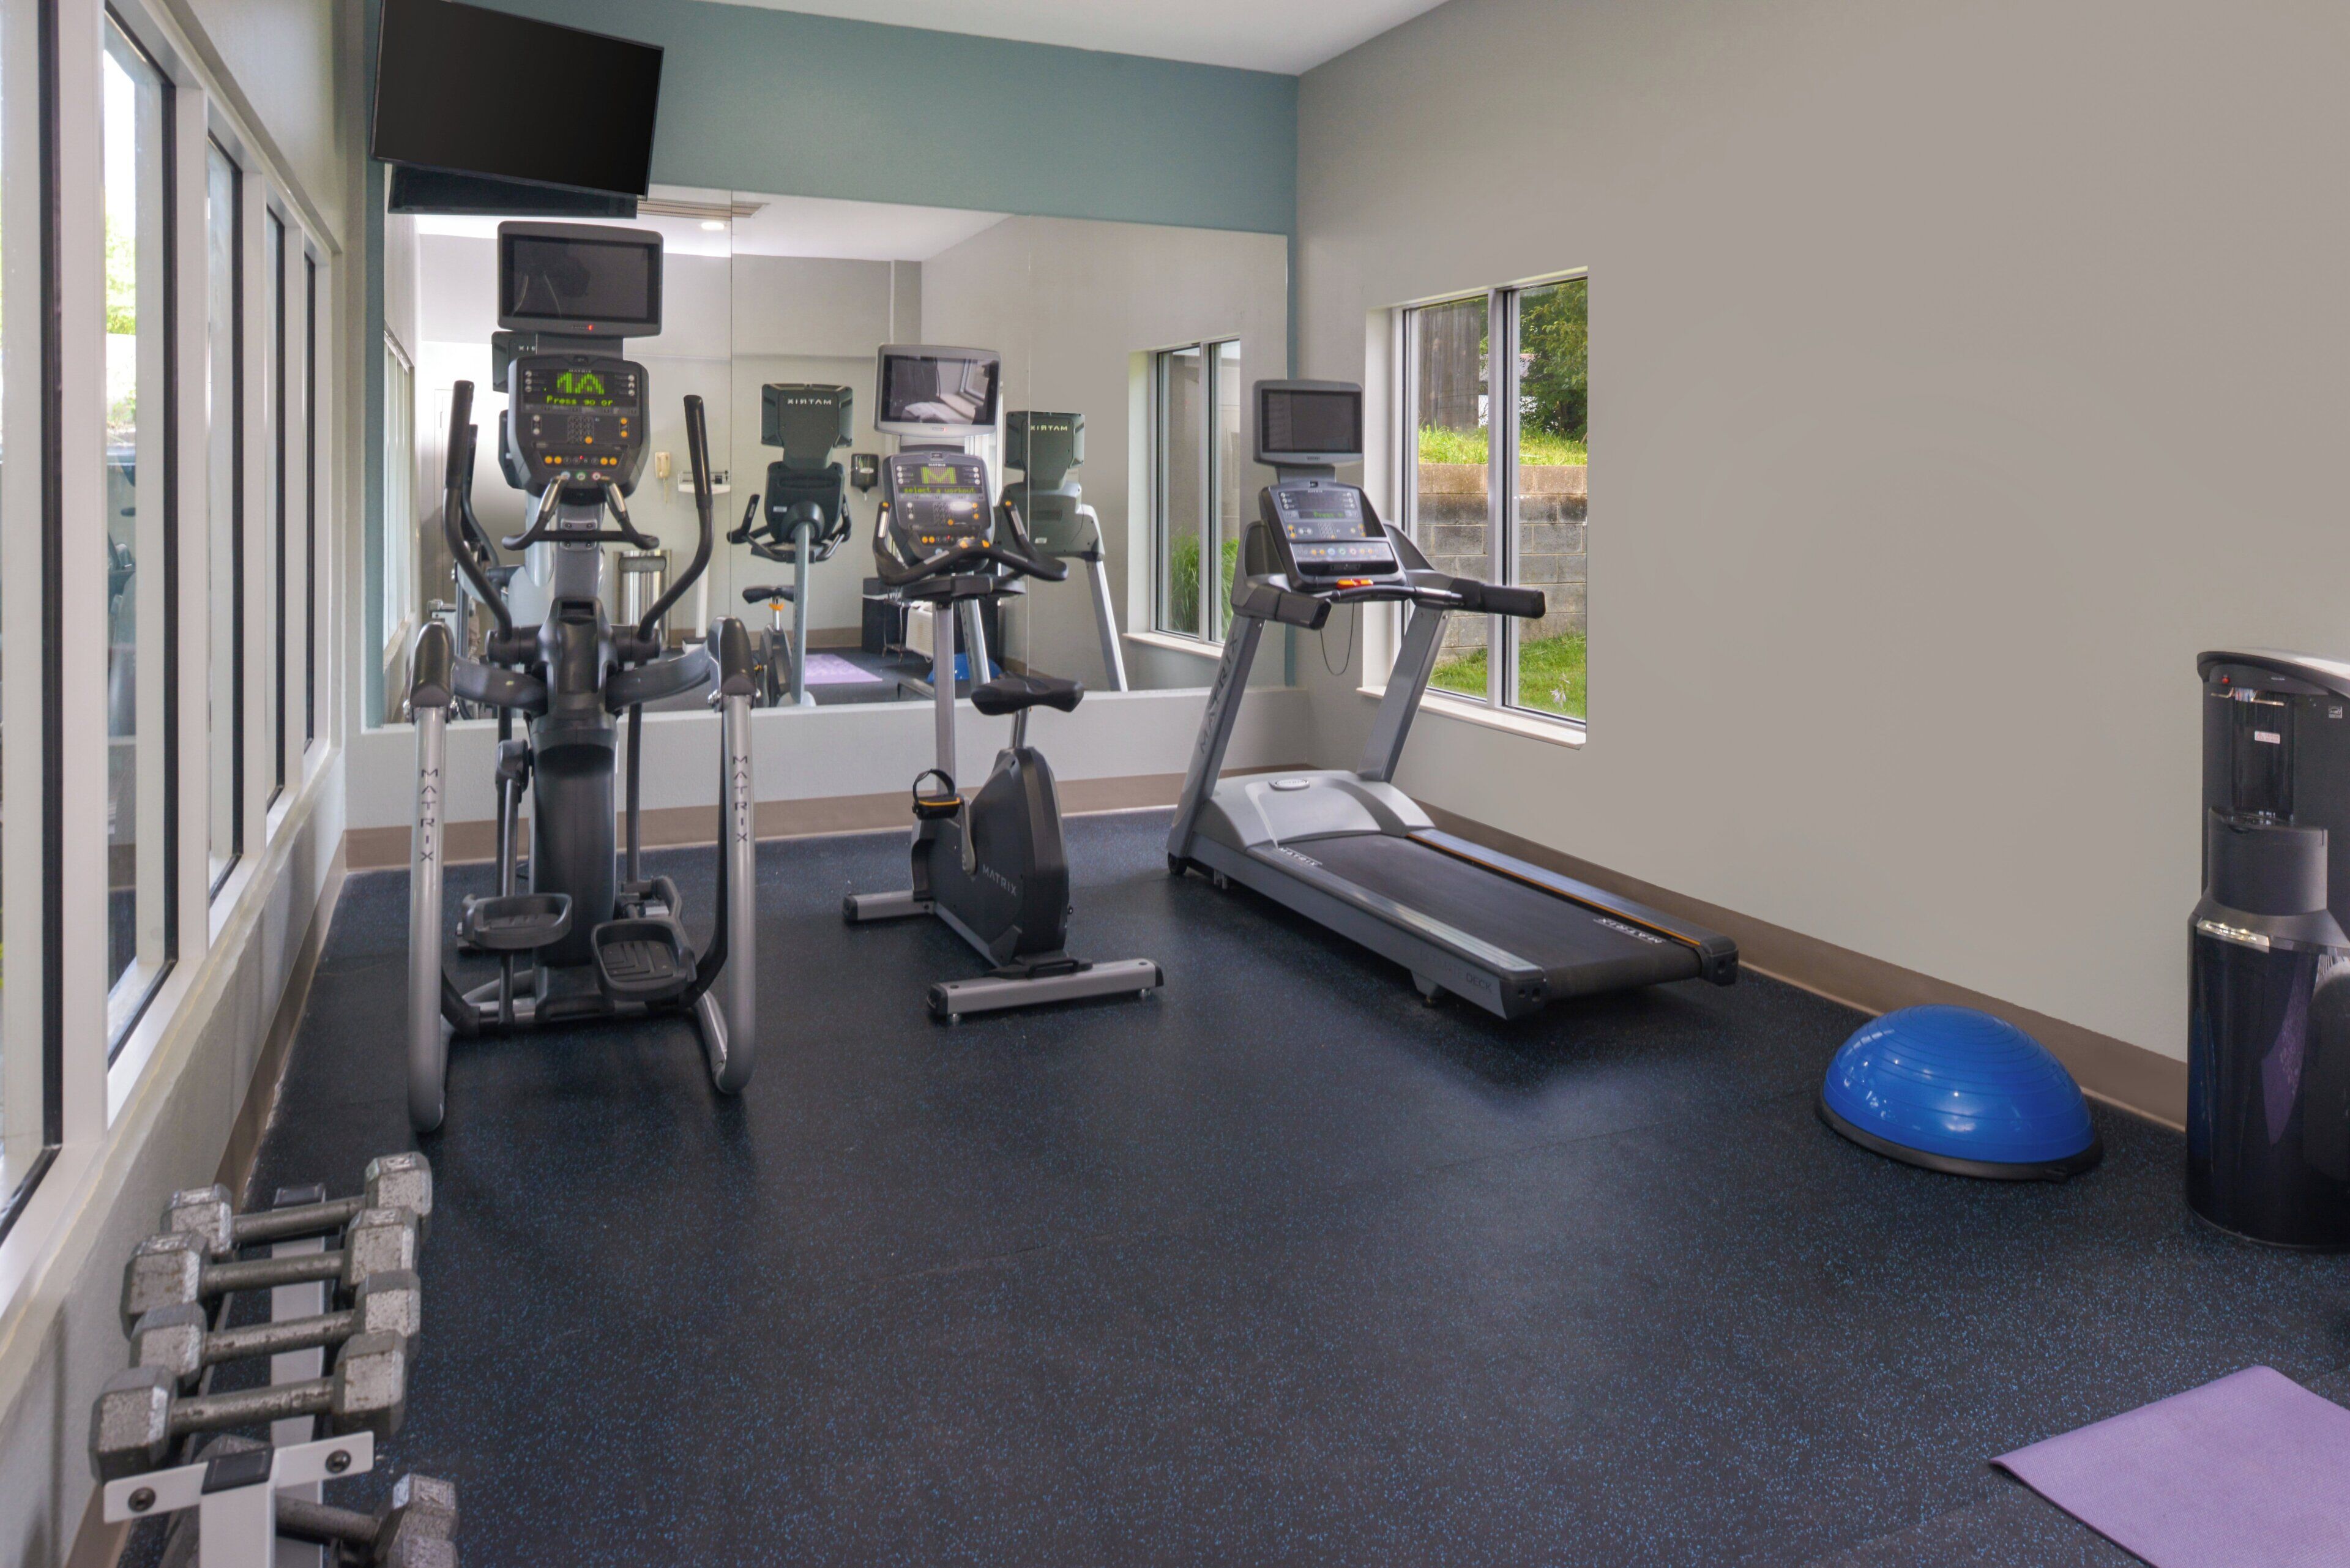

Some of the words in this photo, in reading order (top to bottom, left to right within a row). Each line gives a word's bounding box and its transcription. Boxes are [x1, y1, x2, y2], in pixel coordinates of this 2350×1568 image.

[546, 395, 578, 405] Press
[904, 486, 931, 495] select
[1199, 633, 1237, 754] MATRIX
[732, 755, 748, 842] MATRIX
[420, 769, 438, 861] MATRIX
[1278, 847, 1318, 866] MATRIX
[982, 864, 1016, 897] MATRIX
[1598, 918, 1663, 943] MATRIX
[1466, 971, 1493, 993] DECK
